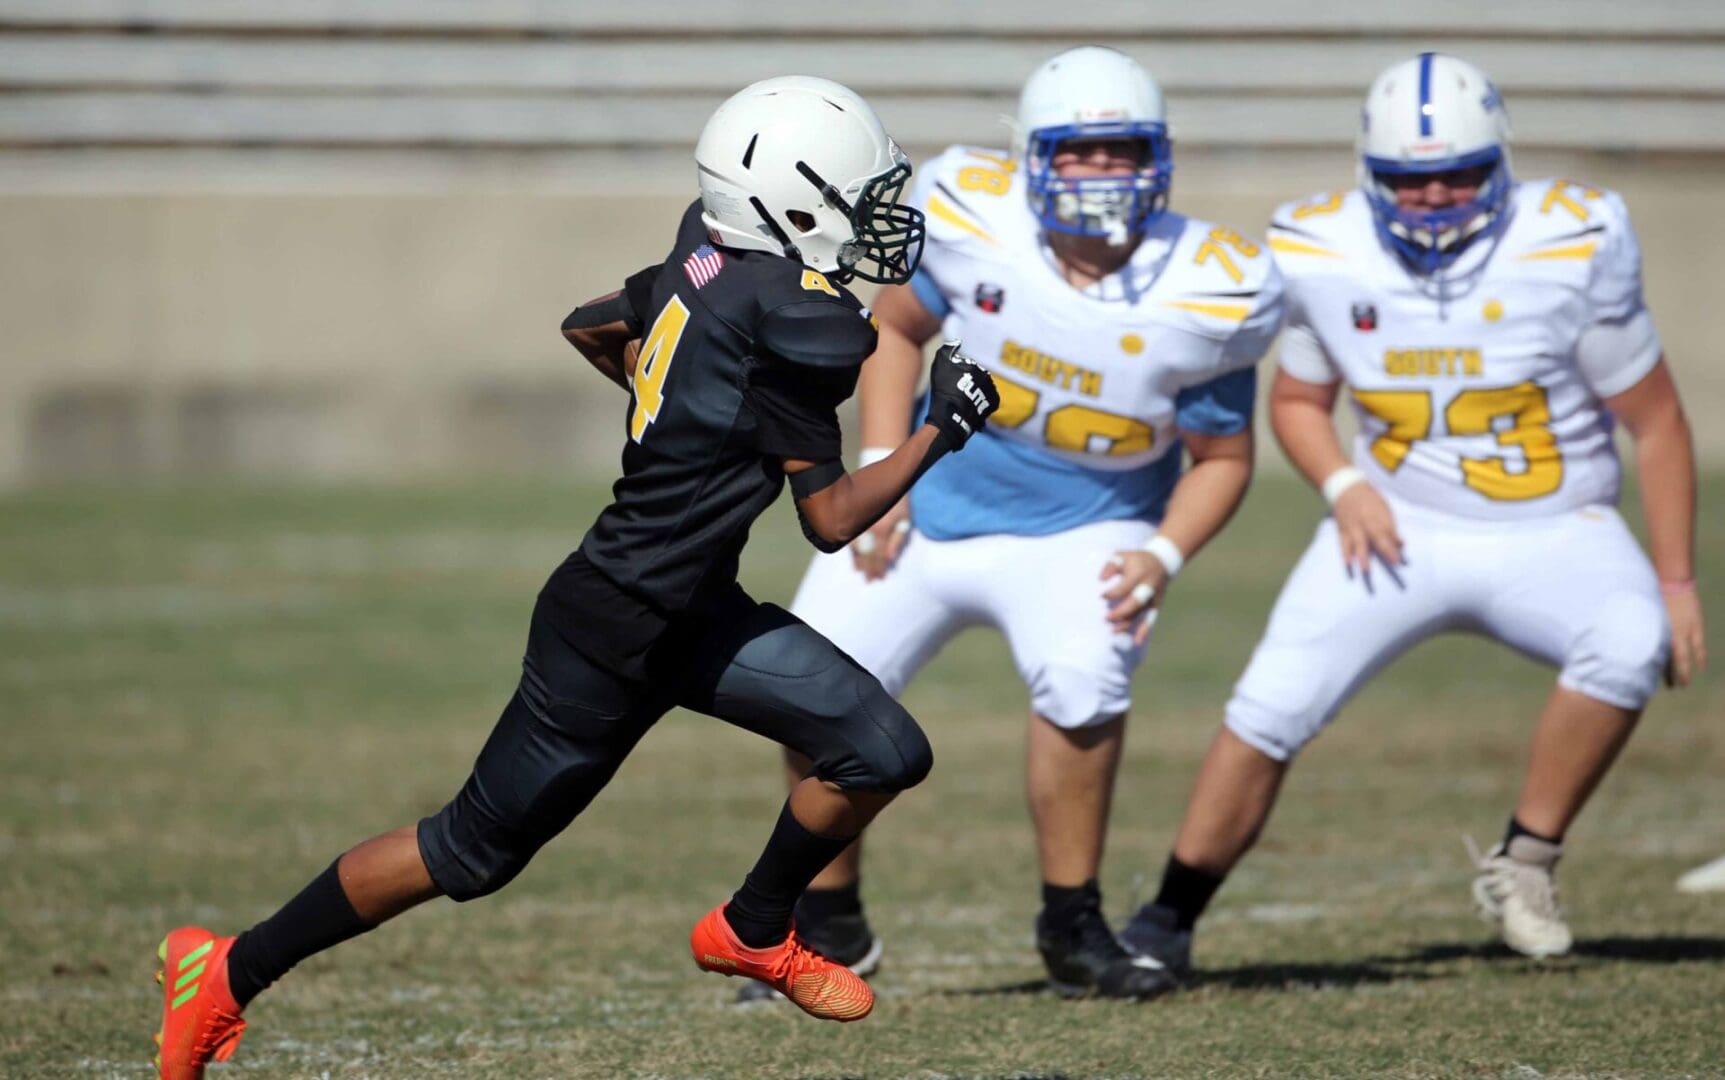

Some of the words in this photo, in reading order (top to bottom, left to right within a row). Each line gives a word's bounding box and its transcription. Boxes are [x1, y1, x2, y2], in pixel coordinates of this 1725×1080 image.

[801, 269, 841, 298] 4
[631, 293, 691, 445] 4
[1001, 339, 1104, 398] SOUTH
[1383, 348, 1484, 376] SOUTH
[1352, 379, 1564, 502] 73
